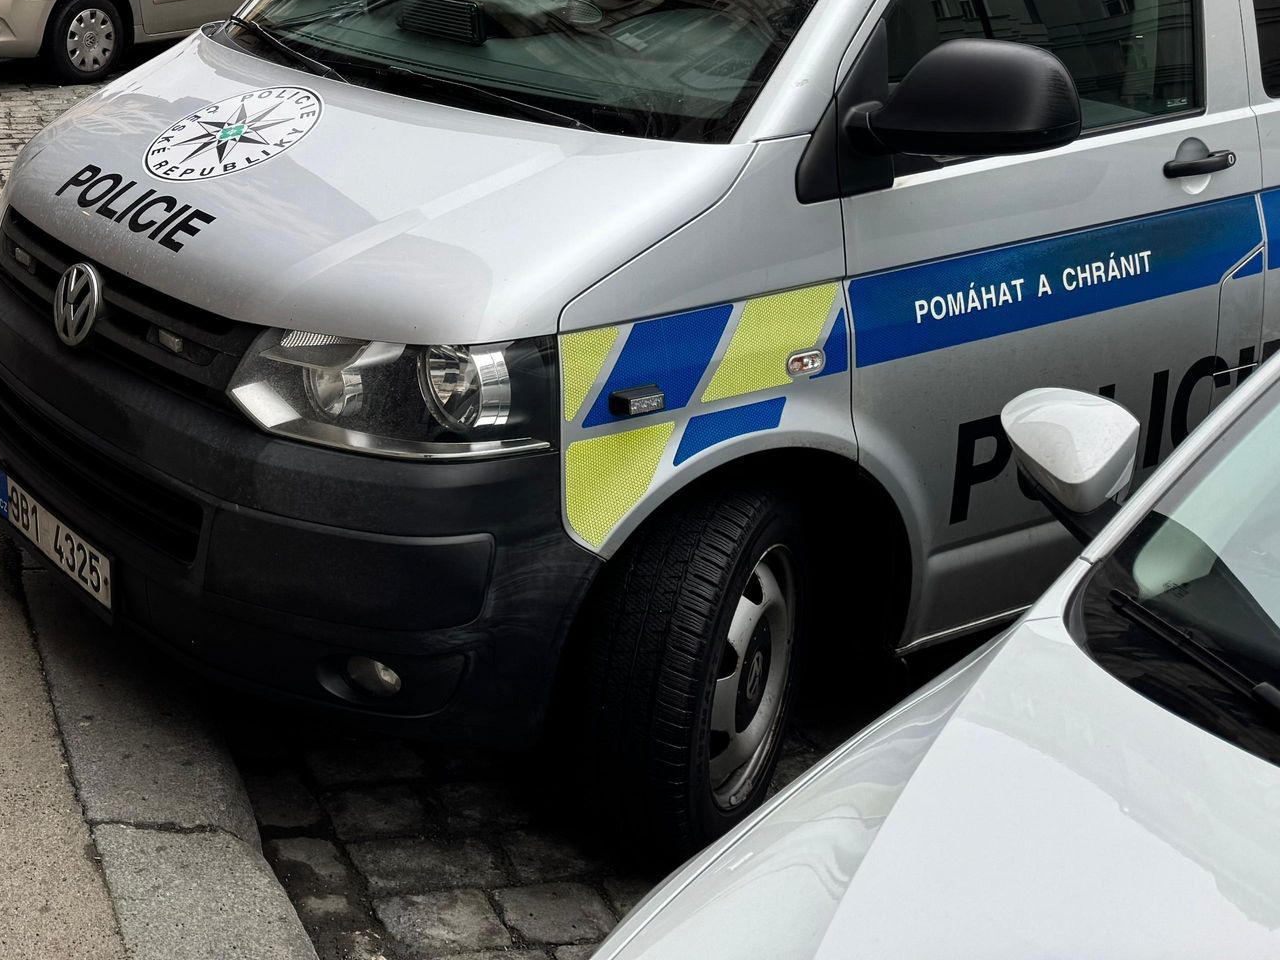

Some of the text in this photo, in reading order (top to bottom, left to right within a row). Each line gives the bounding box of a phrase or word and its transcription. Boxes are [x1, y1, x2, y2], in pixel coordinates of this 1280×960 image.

[240, 89, 316, 120] POLICIE
[152, 127, 304, 178] REPUBLIKY
[55, 164, 217, 253] POLICIE
[914, 250, 1153, 324] POMÁHAT A CHRÁNIT
[0, 498, 8, 513] CZ
[10, 486, 102, 593] 9B1 4325
